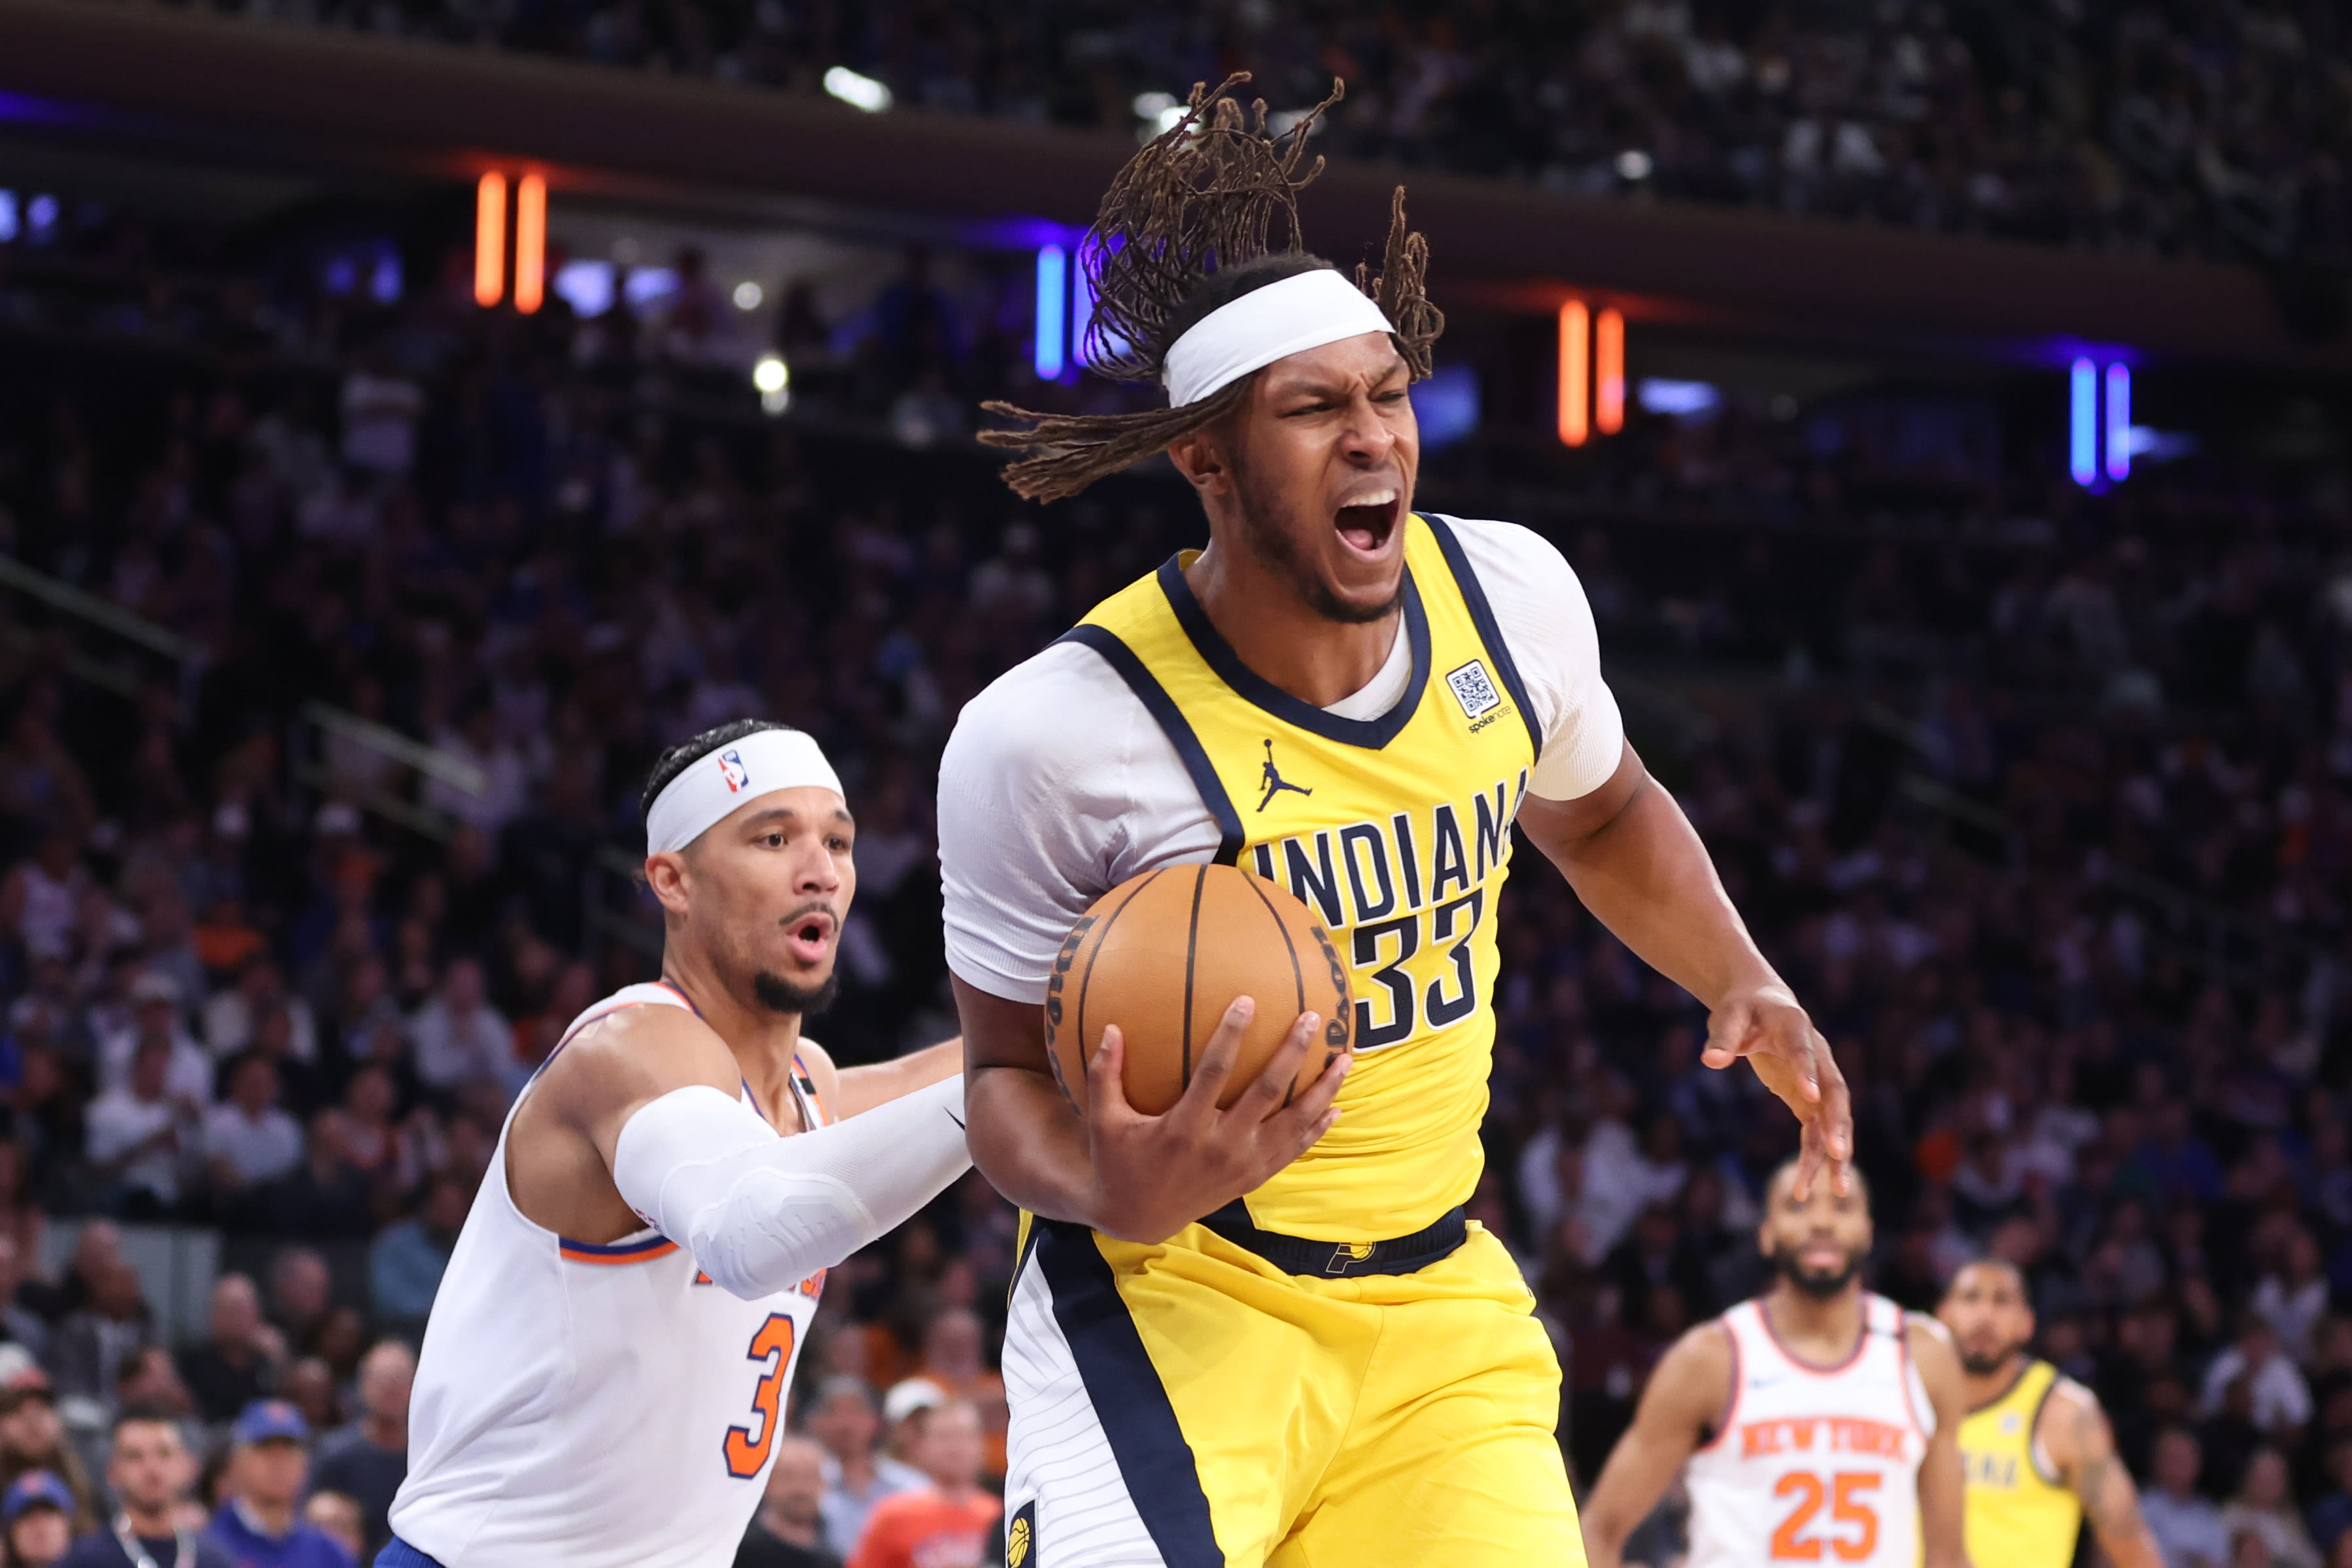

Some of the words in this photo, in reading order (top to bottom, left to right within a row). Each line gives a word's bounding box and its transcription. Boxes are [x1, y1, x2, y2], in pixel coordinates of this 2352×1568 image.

[1468, 706, 1512, 734] spokenote
[1350, 886, 1484, 1055] 33
[721, 1311, 795, 1480] 3
[1770, 1470, 1882, 1563] 25
